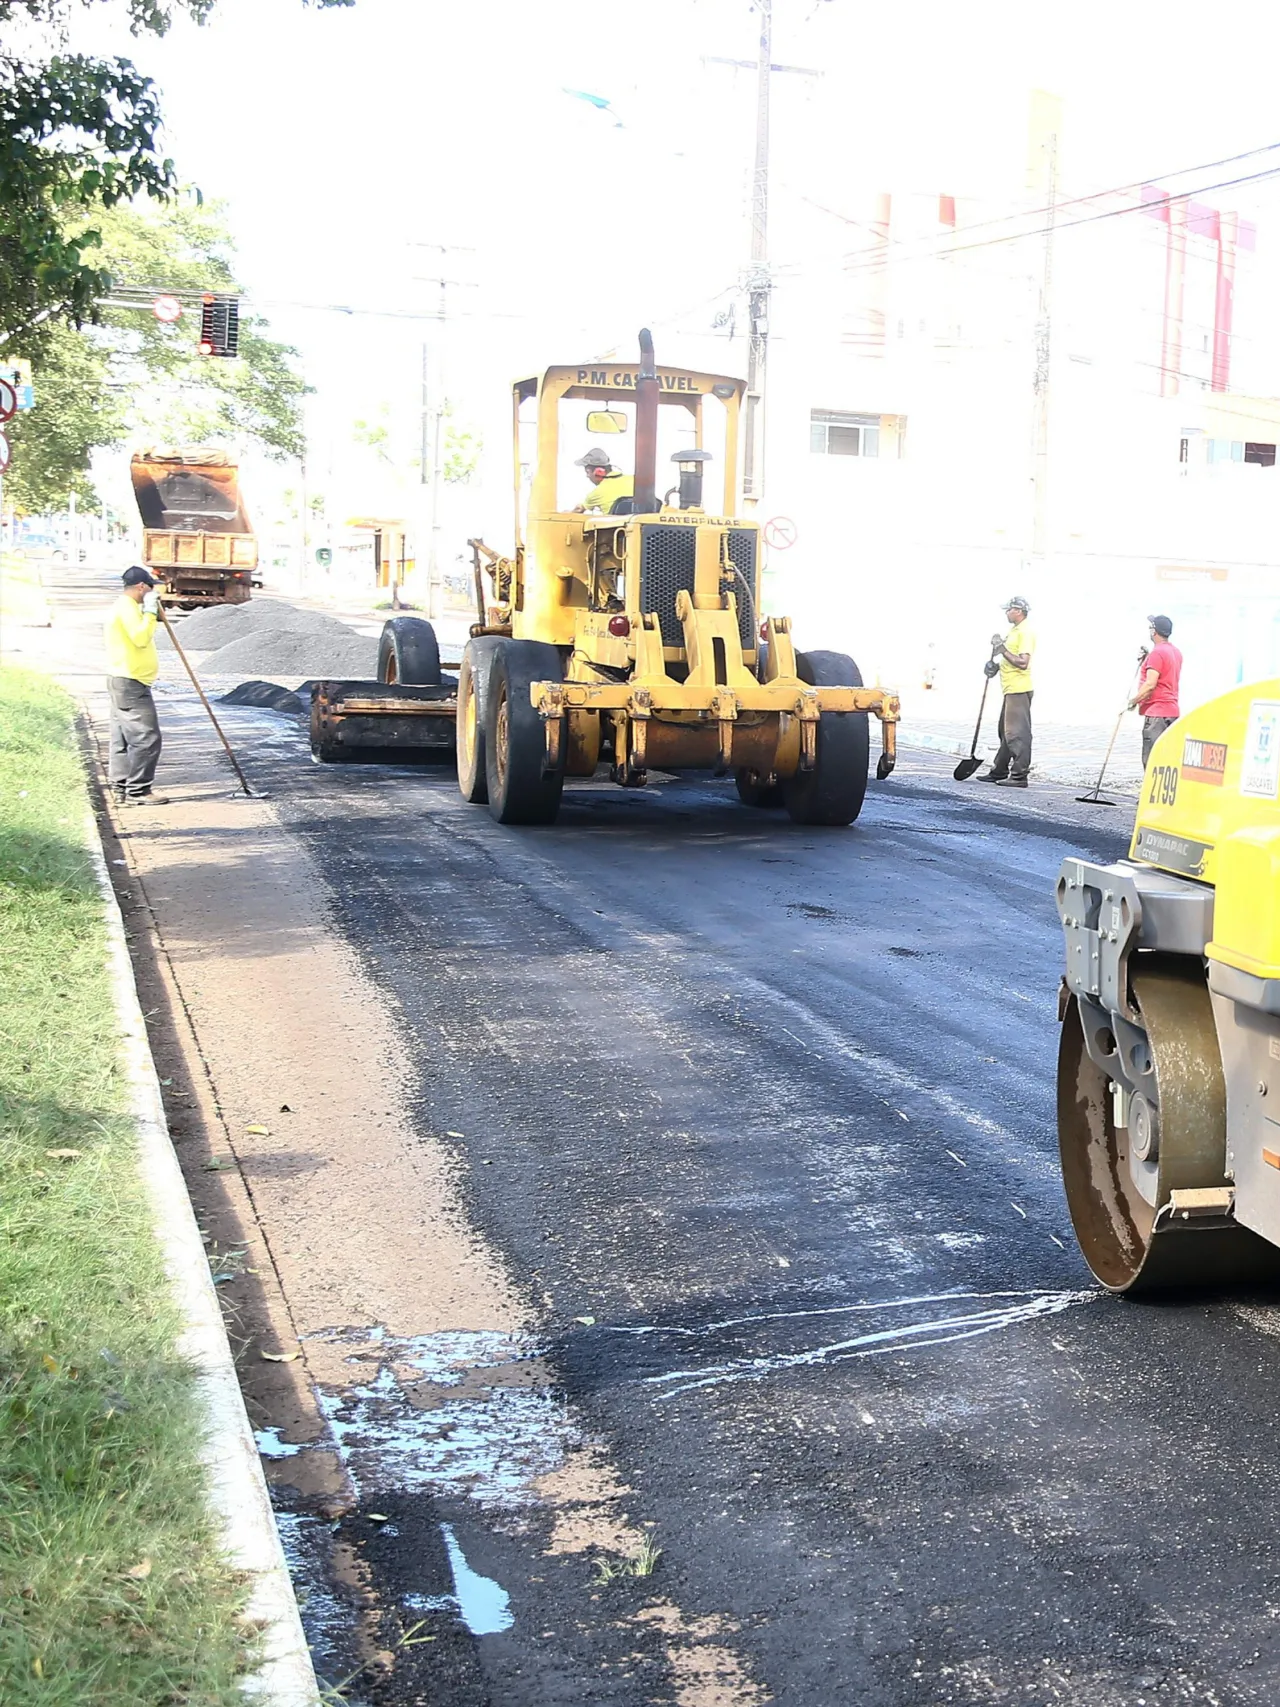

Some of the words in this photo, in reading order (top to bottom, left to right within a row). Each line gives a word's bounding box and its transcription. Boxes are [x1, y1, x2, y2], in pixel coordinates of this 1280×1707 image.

[577, 370, 611, 386] P.M.
[613, 372, 699, 391] CASAVEL
[1149, 766, 1178, 806] 2799
[1146, 834, 1189, 856] DYNAPAC
